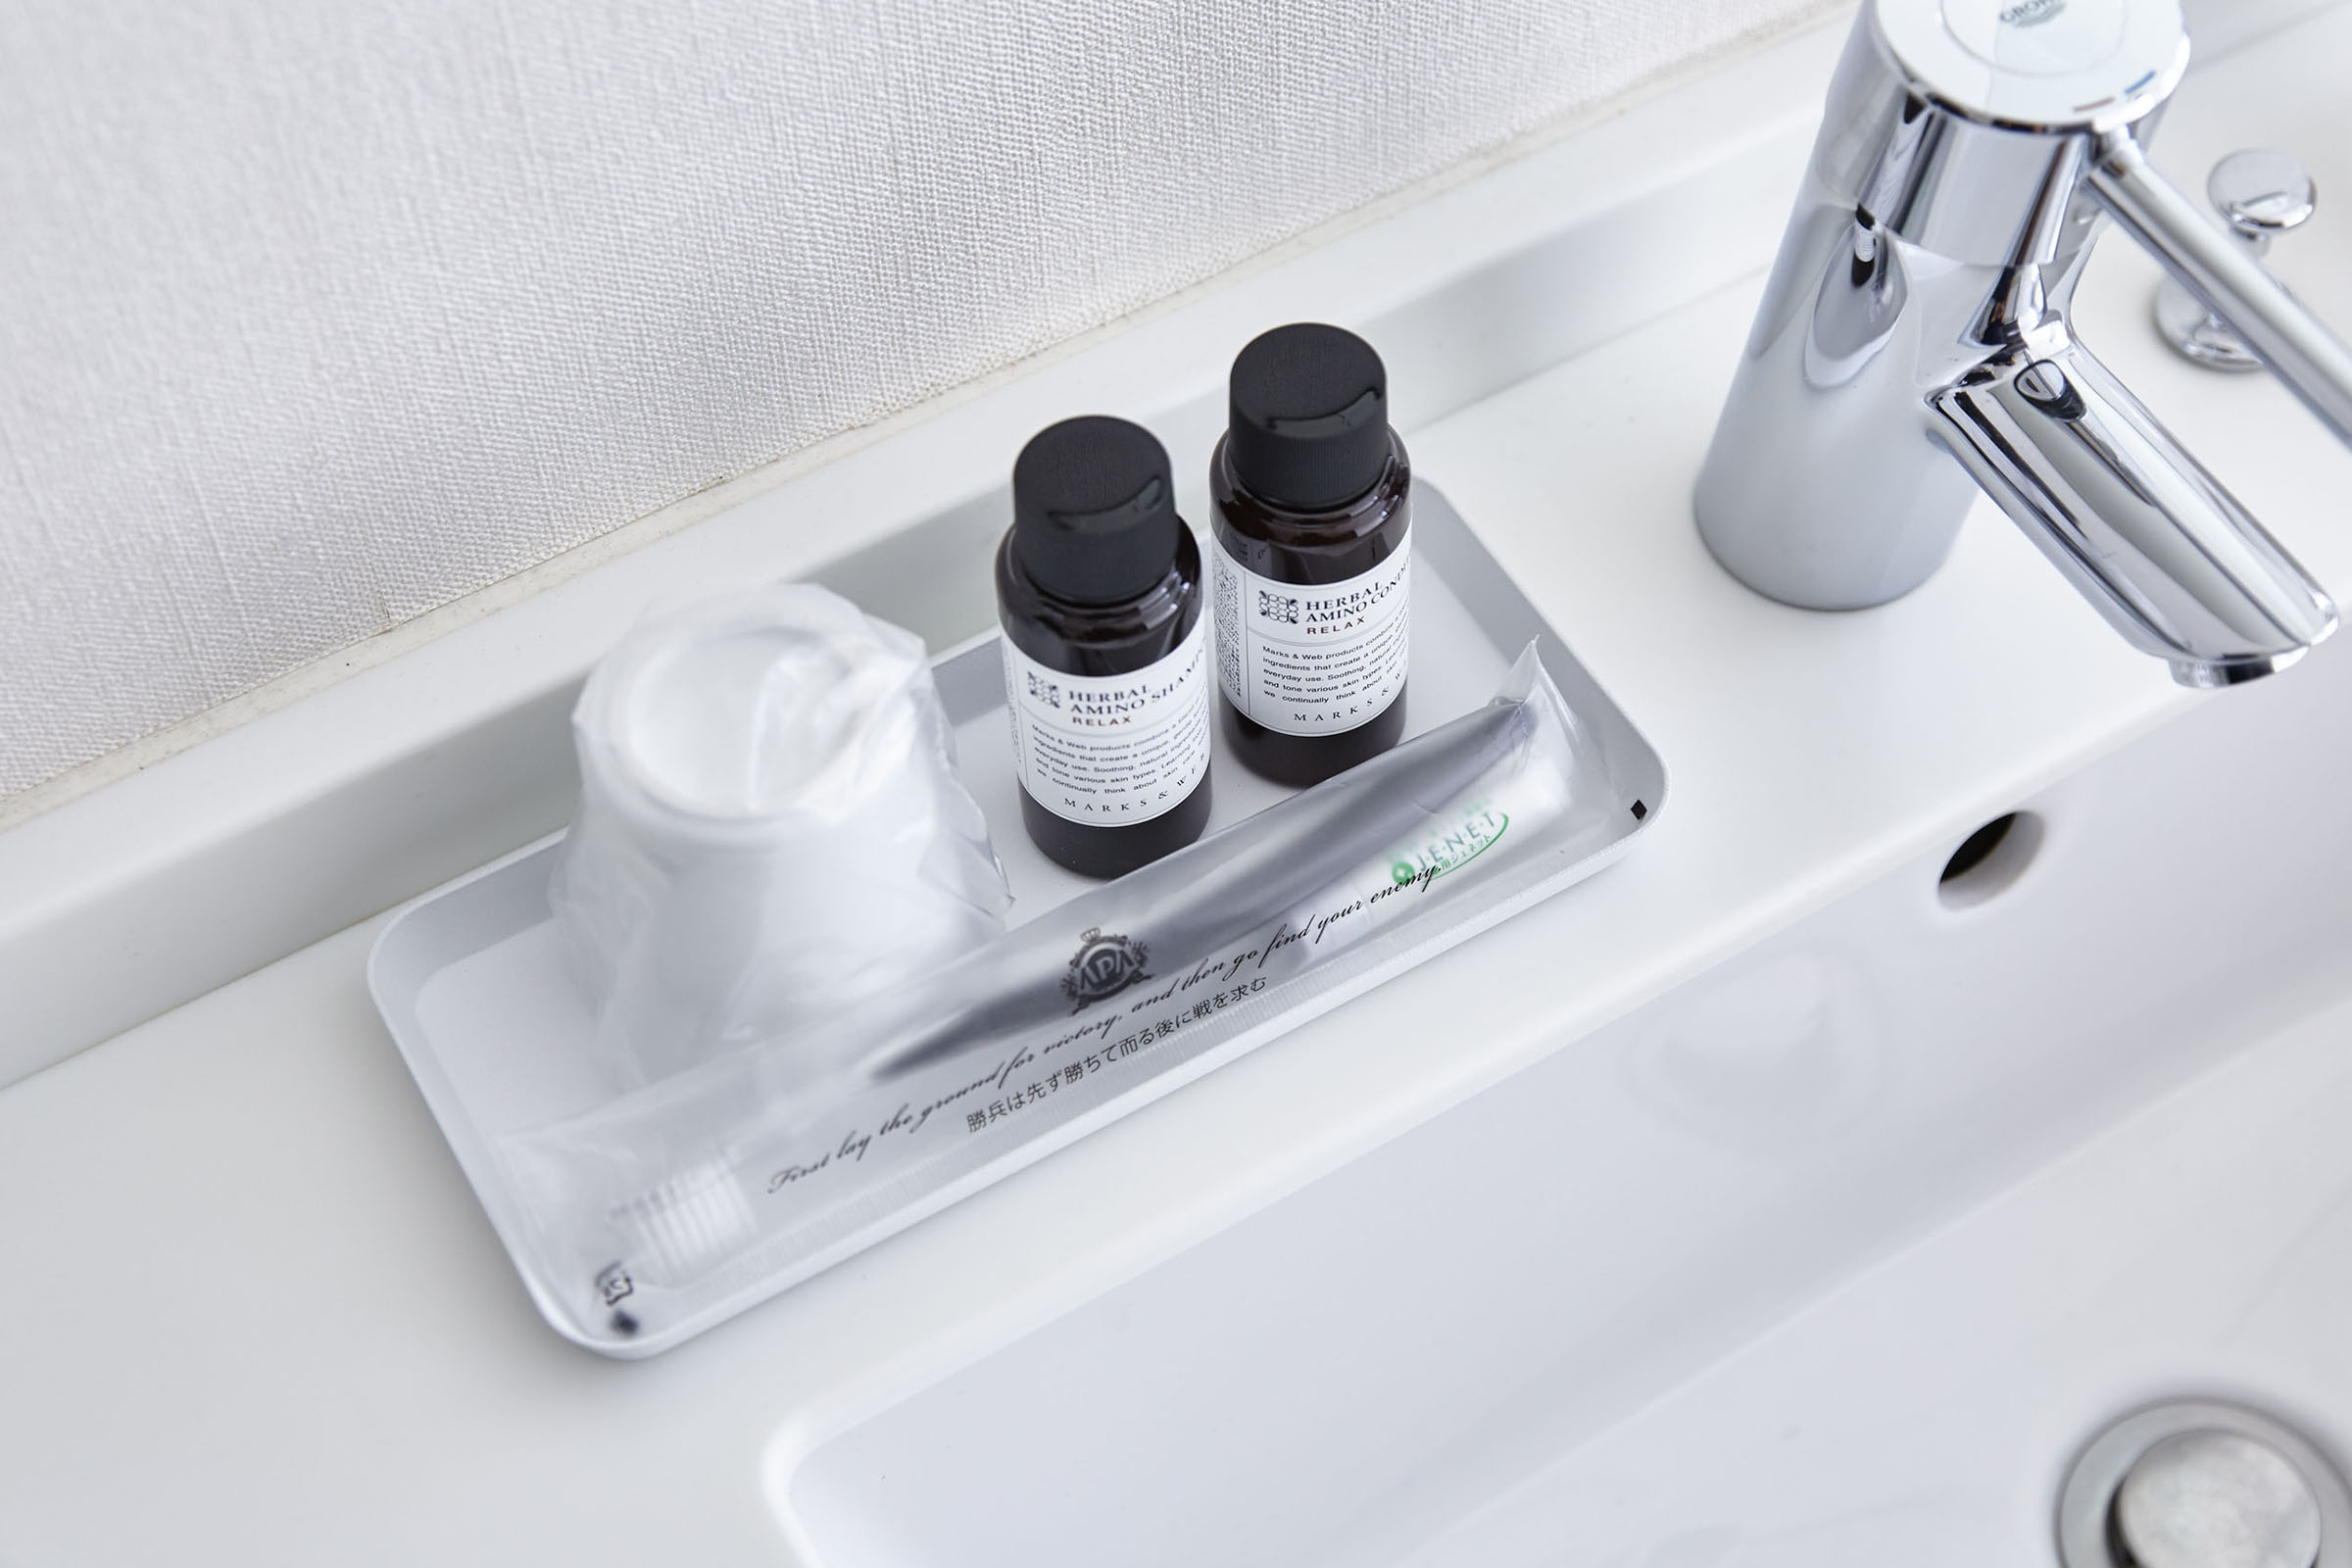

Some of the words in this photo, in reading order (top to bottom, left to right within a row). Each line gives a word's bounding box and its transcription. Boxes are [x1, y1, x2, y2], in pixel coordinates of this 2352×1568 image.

[1307, 580, 1383, 611] HERBAL
[1306, 601, 1367, 622] AMINO
[1307, 617, 1365, 634] RELAX
[1262, 646, 1289, 660] Marks
[1326, 643, 1363, 660] products
[1262, 658, 1310, 671] ingredients
[1335, 657, 1361, 668] create
[1263, 668, 1301, 682] everyday
[1069, 684, 1152, 703] HERBAL
[1264, 678, 1279, 689] and
[1306, 684, 1339, 693] various
[1343, 678, 1359, 687] skin
[1336, 691, 1355, 701] think
[1362, 676, 1382, 691] about
[1071, 699, 1145, 714] AMINO
[1295, 699, 1372, 721] MARKS
[1072, 716, 1131, 725] RELAX
[1032, 724, 1055, 740] Marks
[1067, 740, 1087, 750] Web
[1090, 743, 1130, 752] products
[1134, 729, 1169, 745] combine
[1033, 737, 1075, 759] ingredients
[1080, 753, 1096, 761] that
[1035, 748, 1068, 767] everyday
[1140, 752, 1168, 767] natural
[1036, 758, 1050, 768] and
[1053, 765, 1070, 776] tone
[1074, 775, 1105, 784] various
[1053, 777, 1097, 795] continually
[1134, 779, 1156, 791] about
[1064, 798, 1147, 811] MARKS
[1158, 791, 1168, 800] &
[768, 1152, 831, 1194] First
[836, 1130, 872, 1162] lay
[880, 1102, 912, 1137] the
[909, 1062, 1004, 1133] ground
[997, 1046, 1036, 1090] for
[1131, 984, 1177, 1012] and
[1179, 957, 1229, 1000] then
[1224, 952, 1258, 984] go
[1256, 924, 1311, 970] find
[1309, 899, 1364, 943] your
[1369, 863, 1444, 904] enemy.
[966, 975, 1268, 1133] 勝兵は先ず勝ちて而る後に戦を求む
